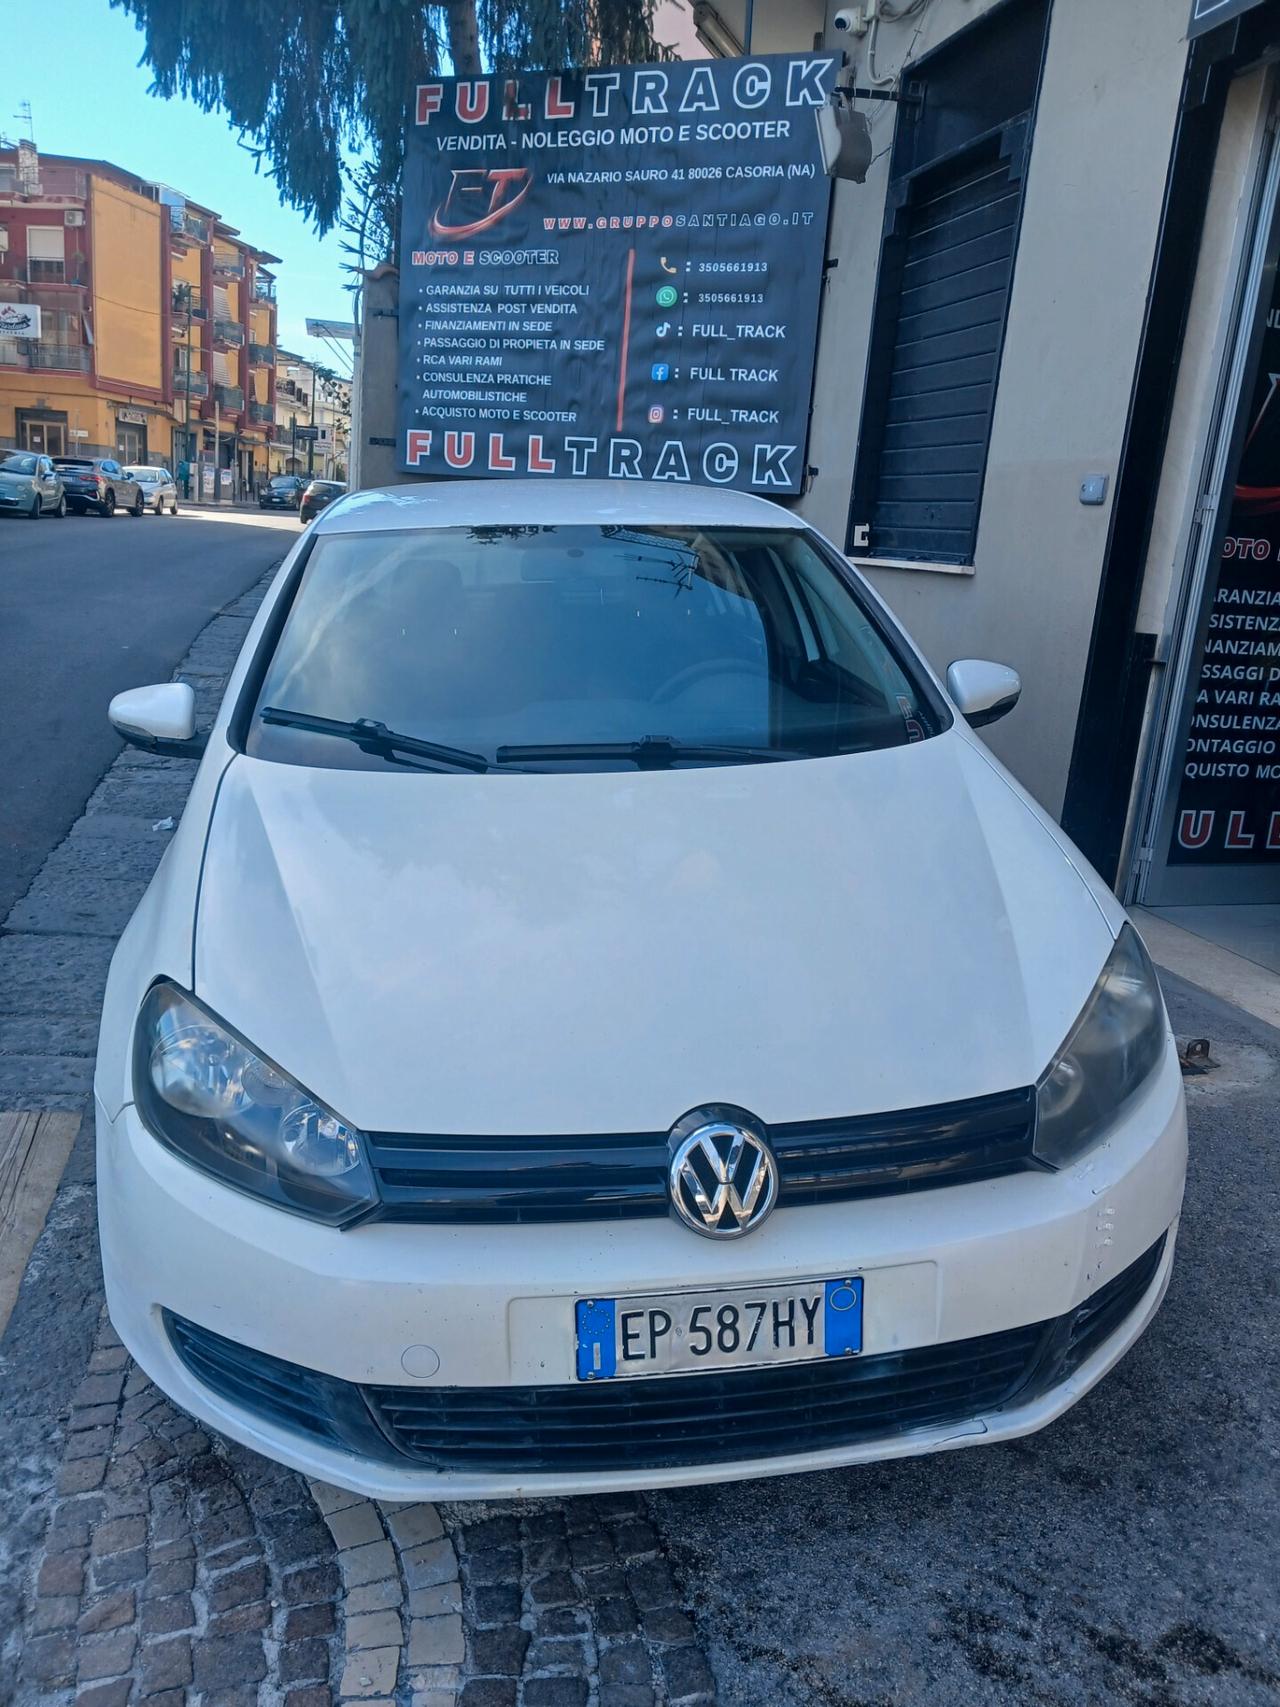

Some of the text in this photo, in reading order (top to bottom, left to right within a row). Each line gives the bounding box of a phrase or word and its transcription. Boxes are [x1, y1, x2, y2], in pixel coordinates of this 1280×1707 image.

[414, 58, 834, 126] FULLTRACK
[436, 133, 507, 151] VENDITA
[522, 128, 615, 149] NOLEGGIO
[620, 126, 673, 145] MOTO
[678, 125, 691, 142] E
[695, 120, 790, 141] SCOOTER
[547, 163, 816, 184] VIA NAZARIO SAURO 41 80026 CASORIA (NA)
[543, 211, 815, 231] WWW.GRUPPOSANTIAGO.IT
[411, 249, 560, 266] MOTO E SCOOTER
[698, 262, 768, 272] 3505661913
[426, 285, 481, 296] GARANZIA
[483, 285, 498, 296] SU
[504, 285, 535, 296] TUTTI
[544, 285, 589, 296] VEICOLI
[698, 293, 764, 303] 3505661913
[425, 303, 578, 315] ASSISTENZA POST VENDITA
[424, 321, 553, 332] FINANZIAMENTI IN SEDE
[692, 325, 786, 341] FULL_TRACK
[423, 337, 605, 351] PASSAGGIO DI PROPIETA IN SEDE
[423, 355, 503, 367] RCA VARI RAMI
[422, 372, 552, 386] CONSULENZA PRATICHE
[690, 367, 725, 381] FULL
[729, 369, 779, 382] TRACK
[422, 389, 527, 403] AUTOMOBILISTICHE
[421, 406, 577, 422] ACQUISTO MOTO E SCOOTER
[687, 408, 779, 425] FULL_TRACK
[406, 429, 797, 486] FULLTRACK
[1213, 588, 1280, 606] RANZIA
[1208, 614, 1280, 631] SISTENZ
[1201, 664, 1264, 681] SSAGGI
[1215, 689, 1254, 705] VARI
[1191, 714, 1280, 731] NSULENZ
[1184, 762, 1250, 779] QUISTO
[621, 1296, 821, 1362] EP 587HY
